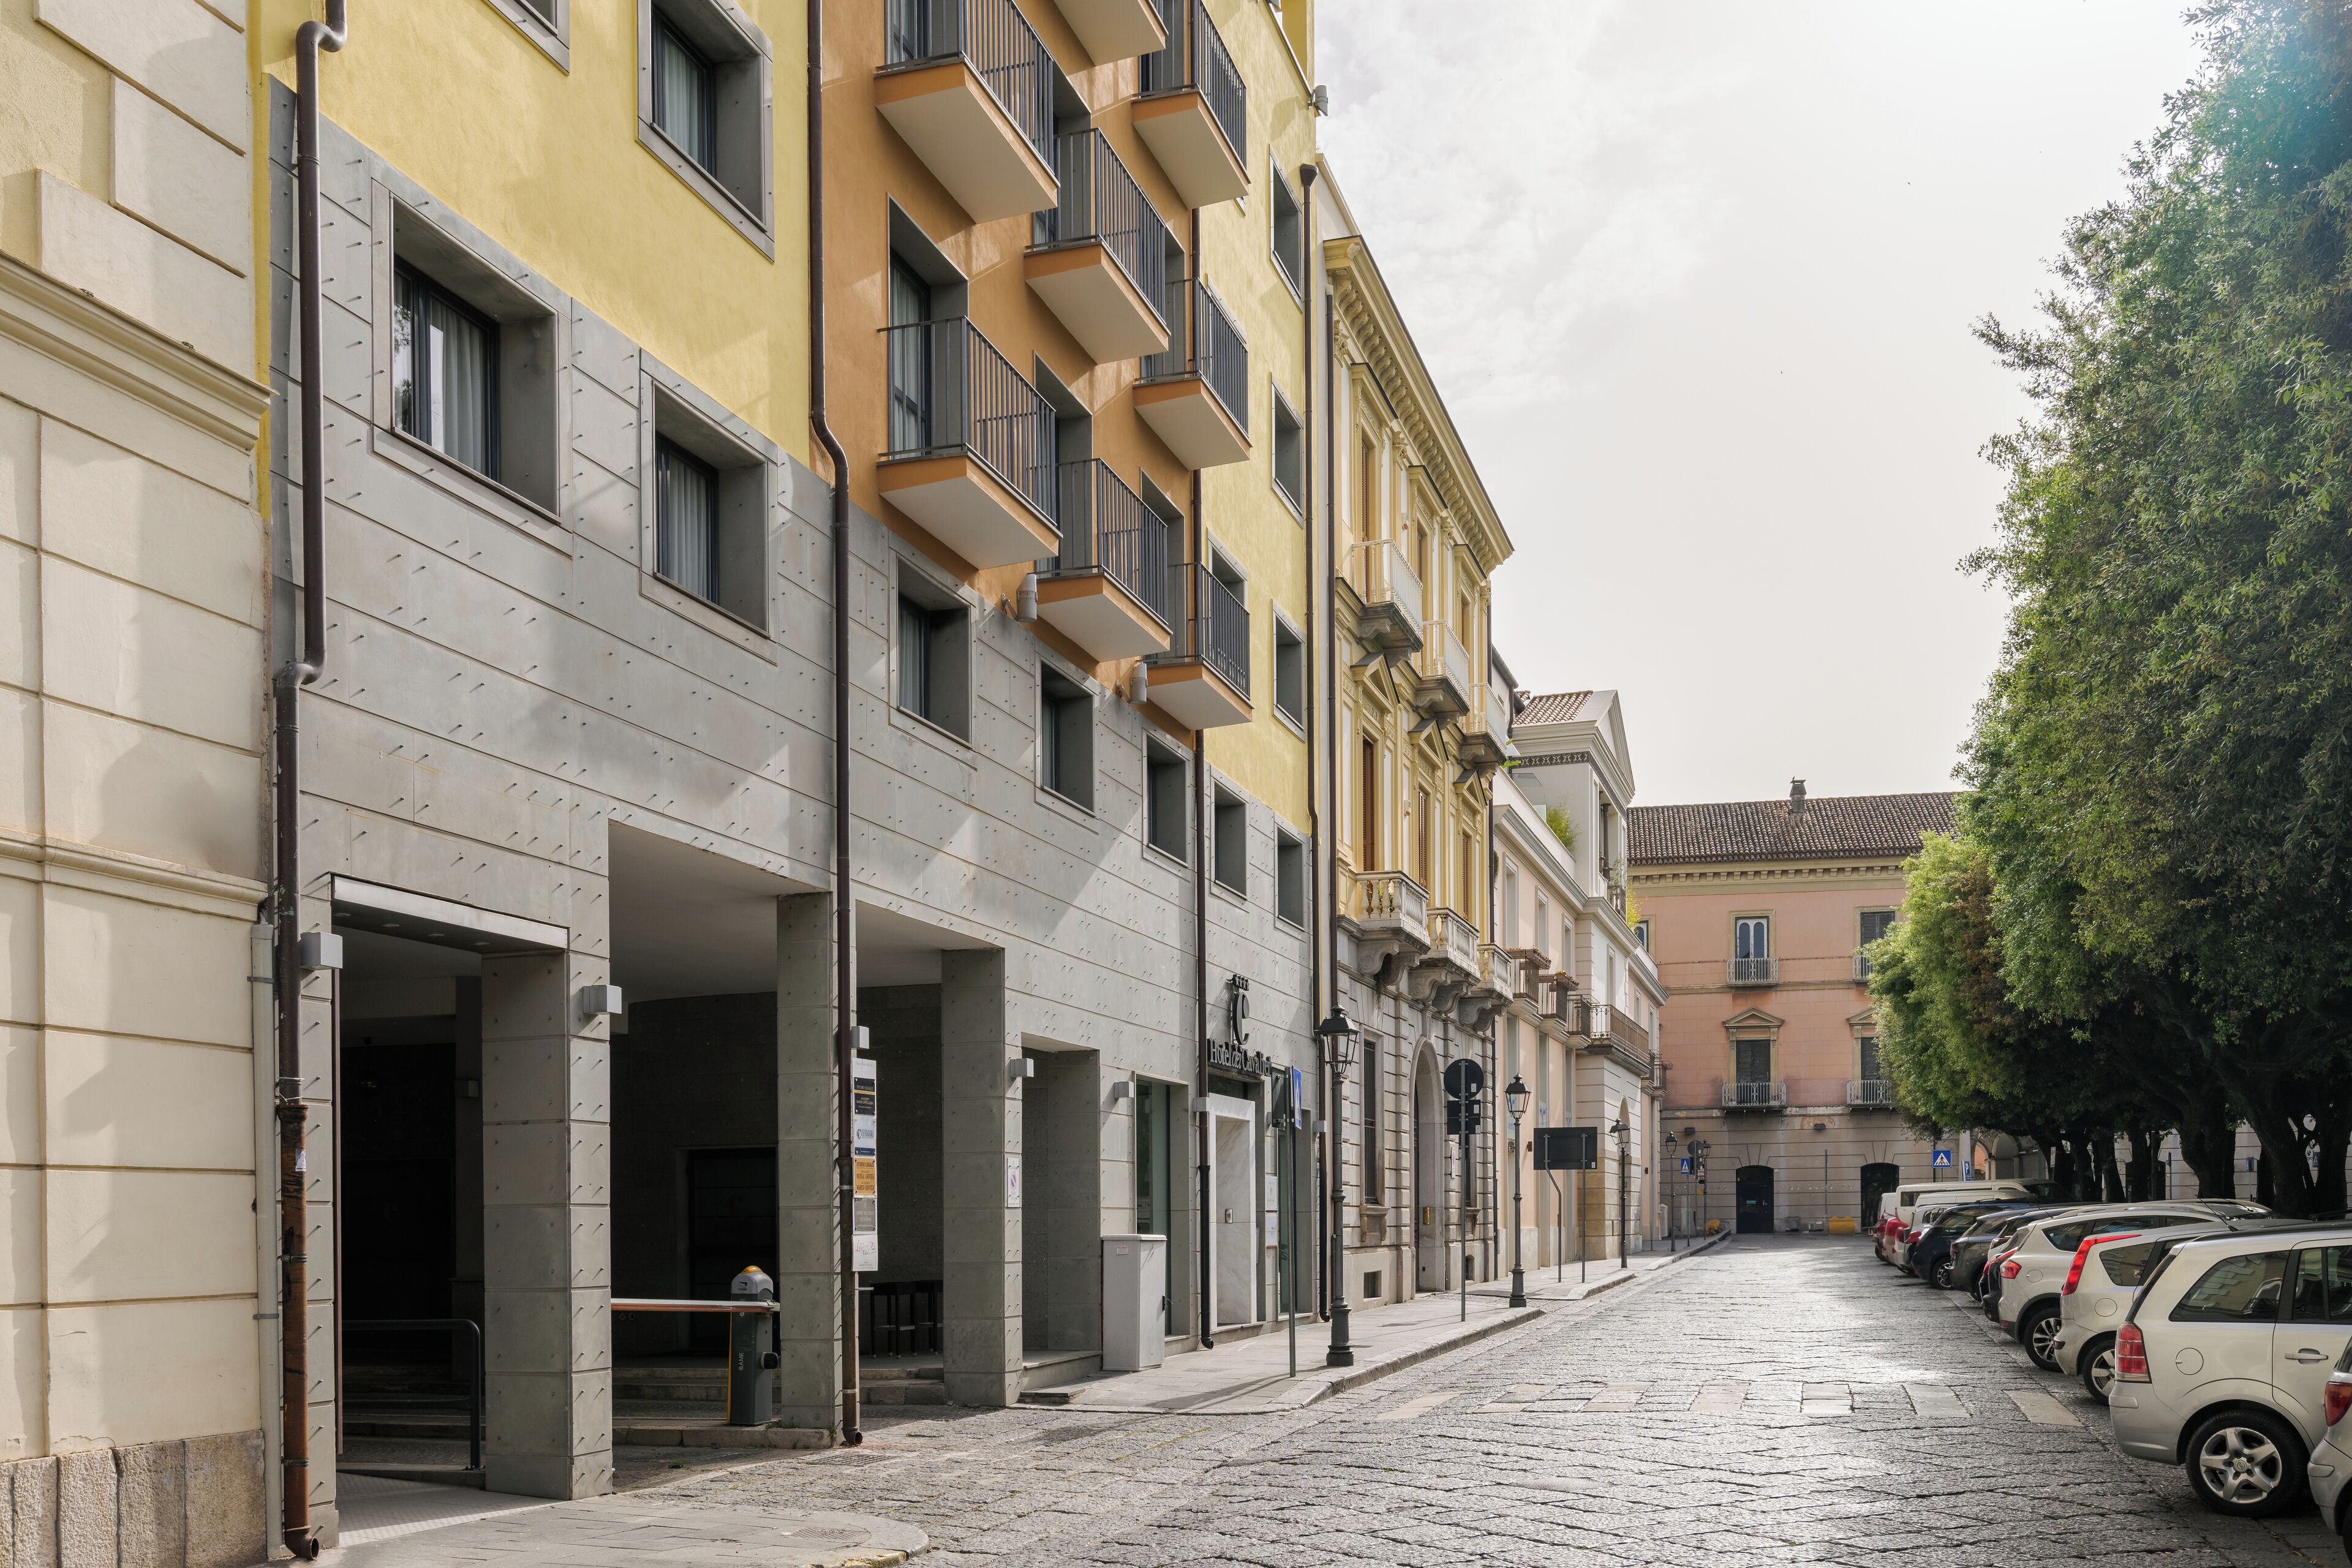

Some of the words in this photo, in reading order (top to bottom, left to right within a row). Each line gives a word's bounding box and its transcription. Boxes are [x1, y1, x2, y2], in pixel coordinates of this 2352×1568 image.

[1210, 1038, 1232, 1066] Hotel
[1232, 1043, 1242, 1069] dei
[1242, 1047, 1272, 1077] Cavalieri
[1966, 1163, 1969, 1174] P
